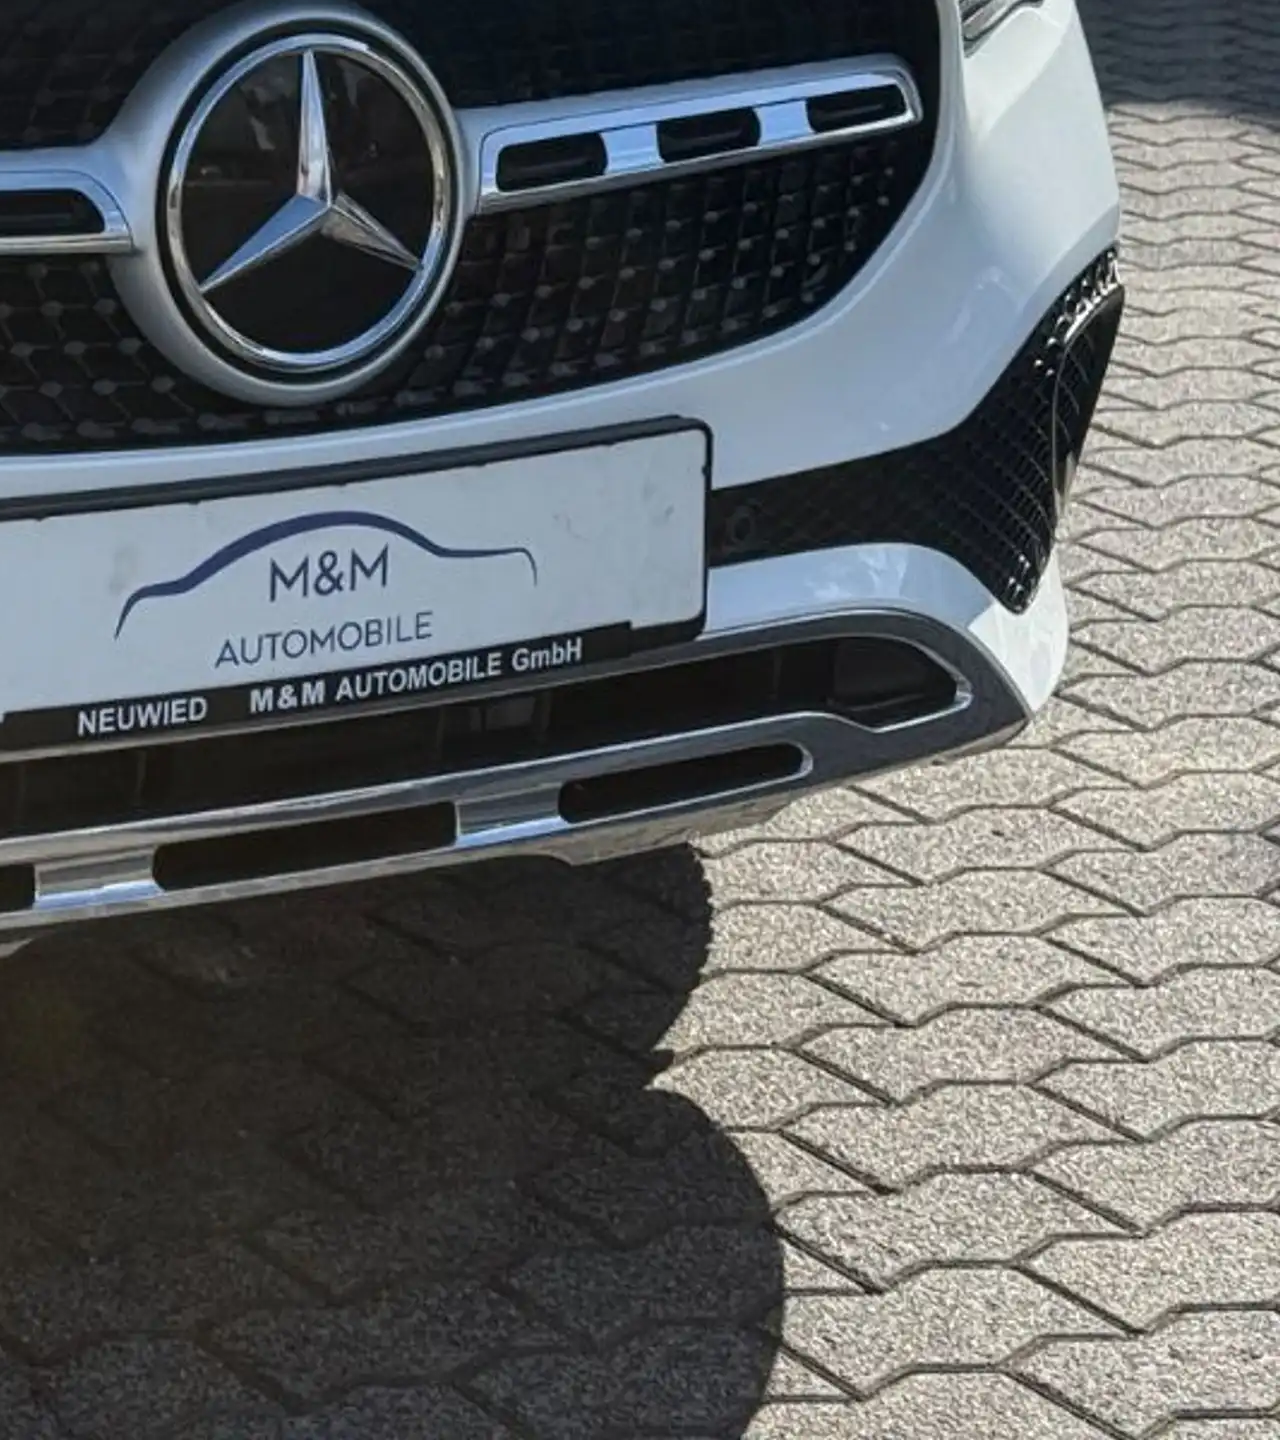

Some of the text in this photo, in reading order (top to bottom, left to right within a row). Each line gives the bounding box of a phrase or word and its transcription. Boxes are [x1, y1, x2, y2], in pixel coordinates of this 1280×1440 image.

[269, 541, 389, 603] M&M
[214, 610, 434, 670] AUTOMOBILE
[77, 636, 583, 737] NEUWIED M&M AUTOMOBILE GmbH
